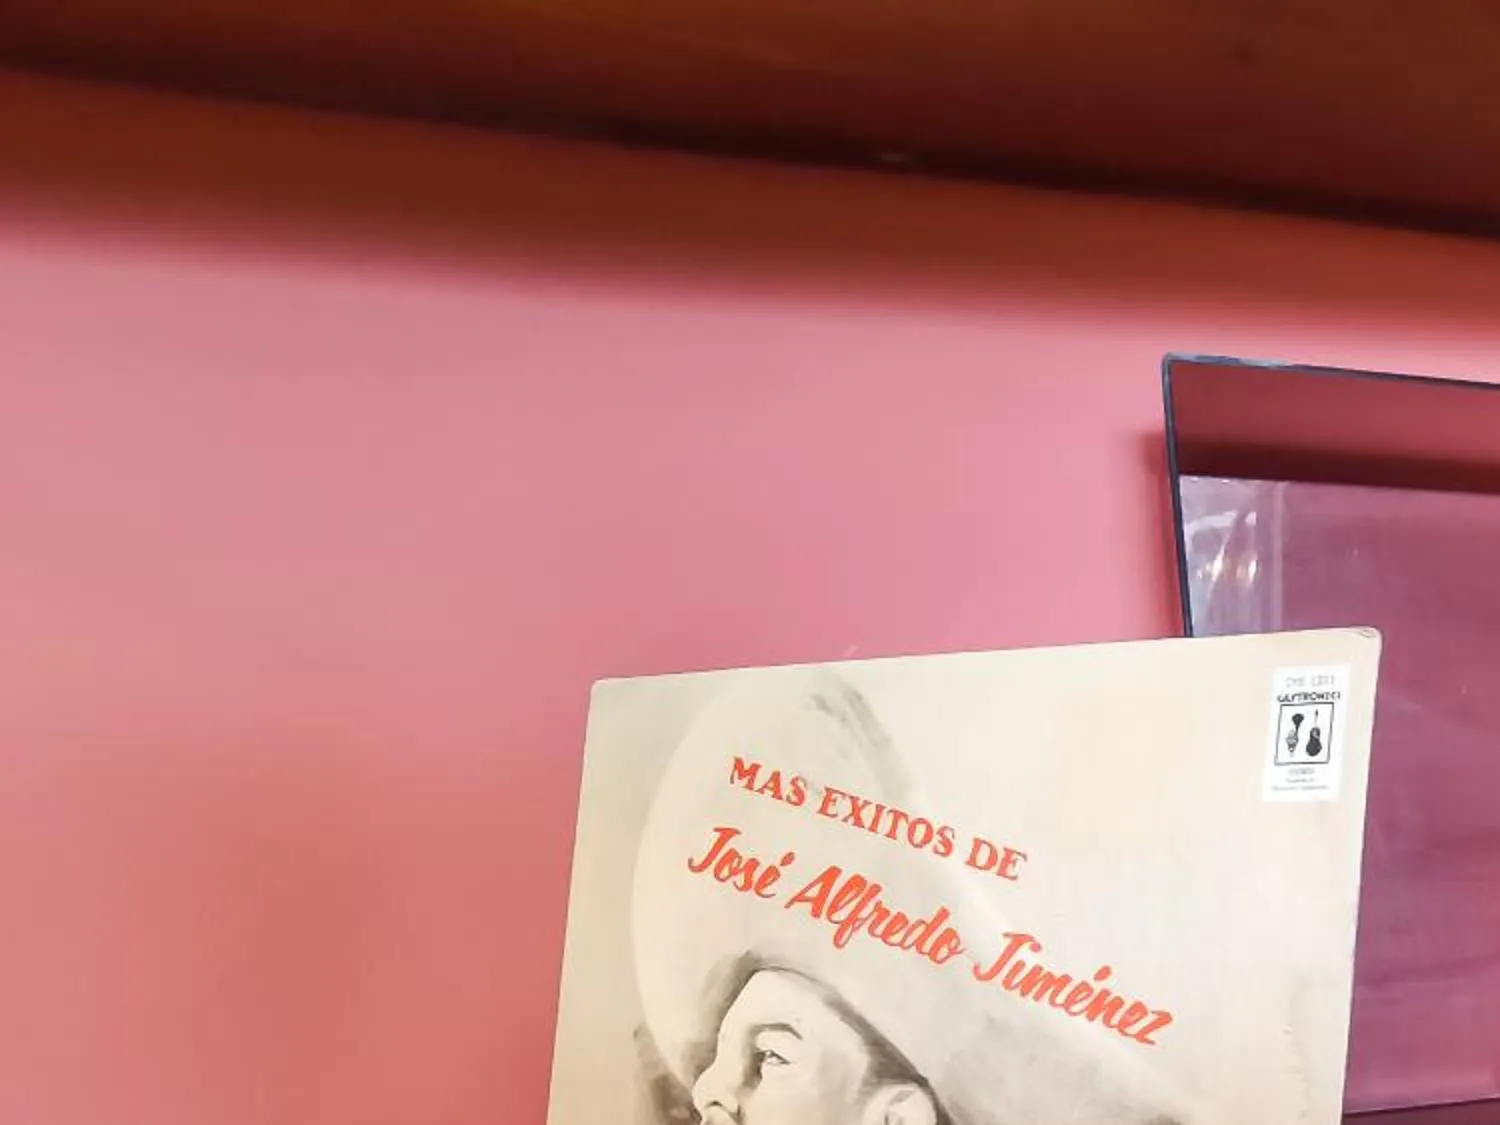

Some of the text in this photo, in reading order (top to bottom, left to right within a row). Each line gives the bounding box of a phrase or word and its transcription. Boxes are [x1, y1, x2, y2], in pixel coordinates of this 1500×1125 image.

[729, 755, 1029, 881] MAS EXITOS DE
[688, 827, 1174, 1046] José Alfredo Jiménez
